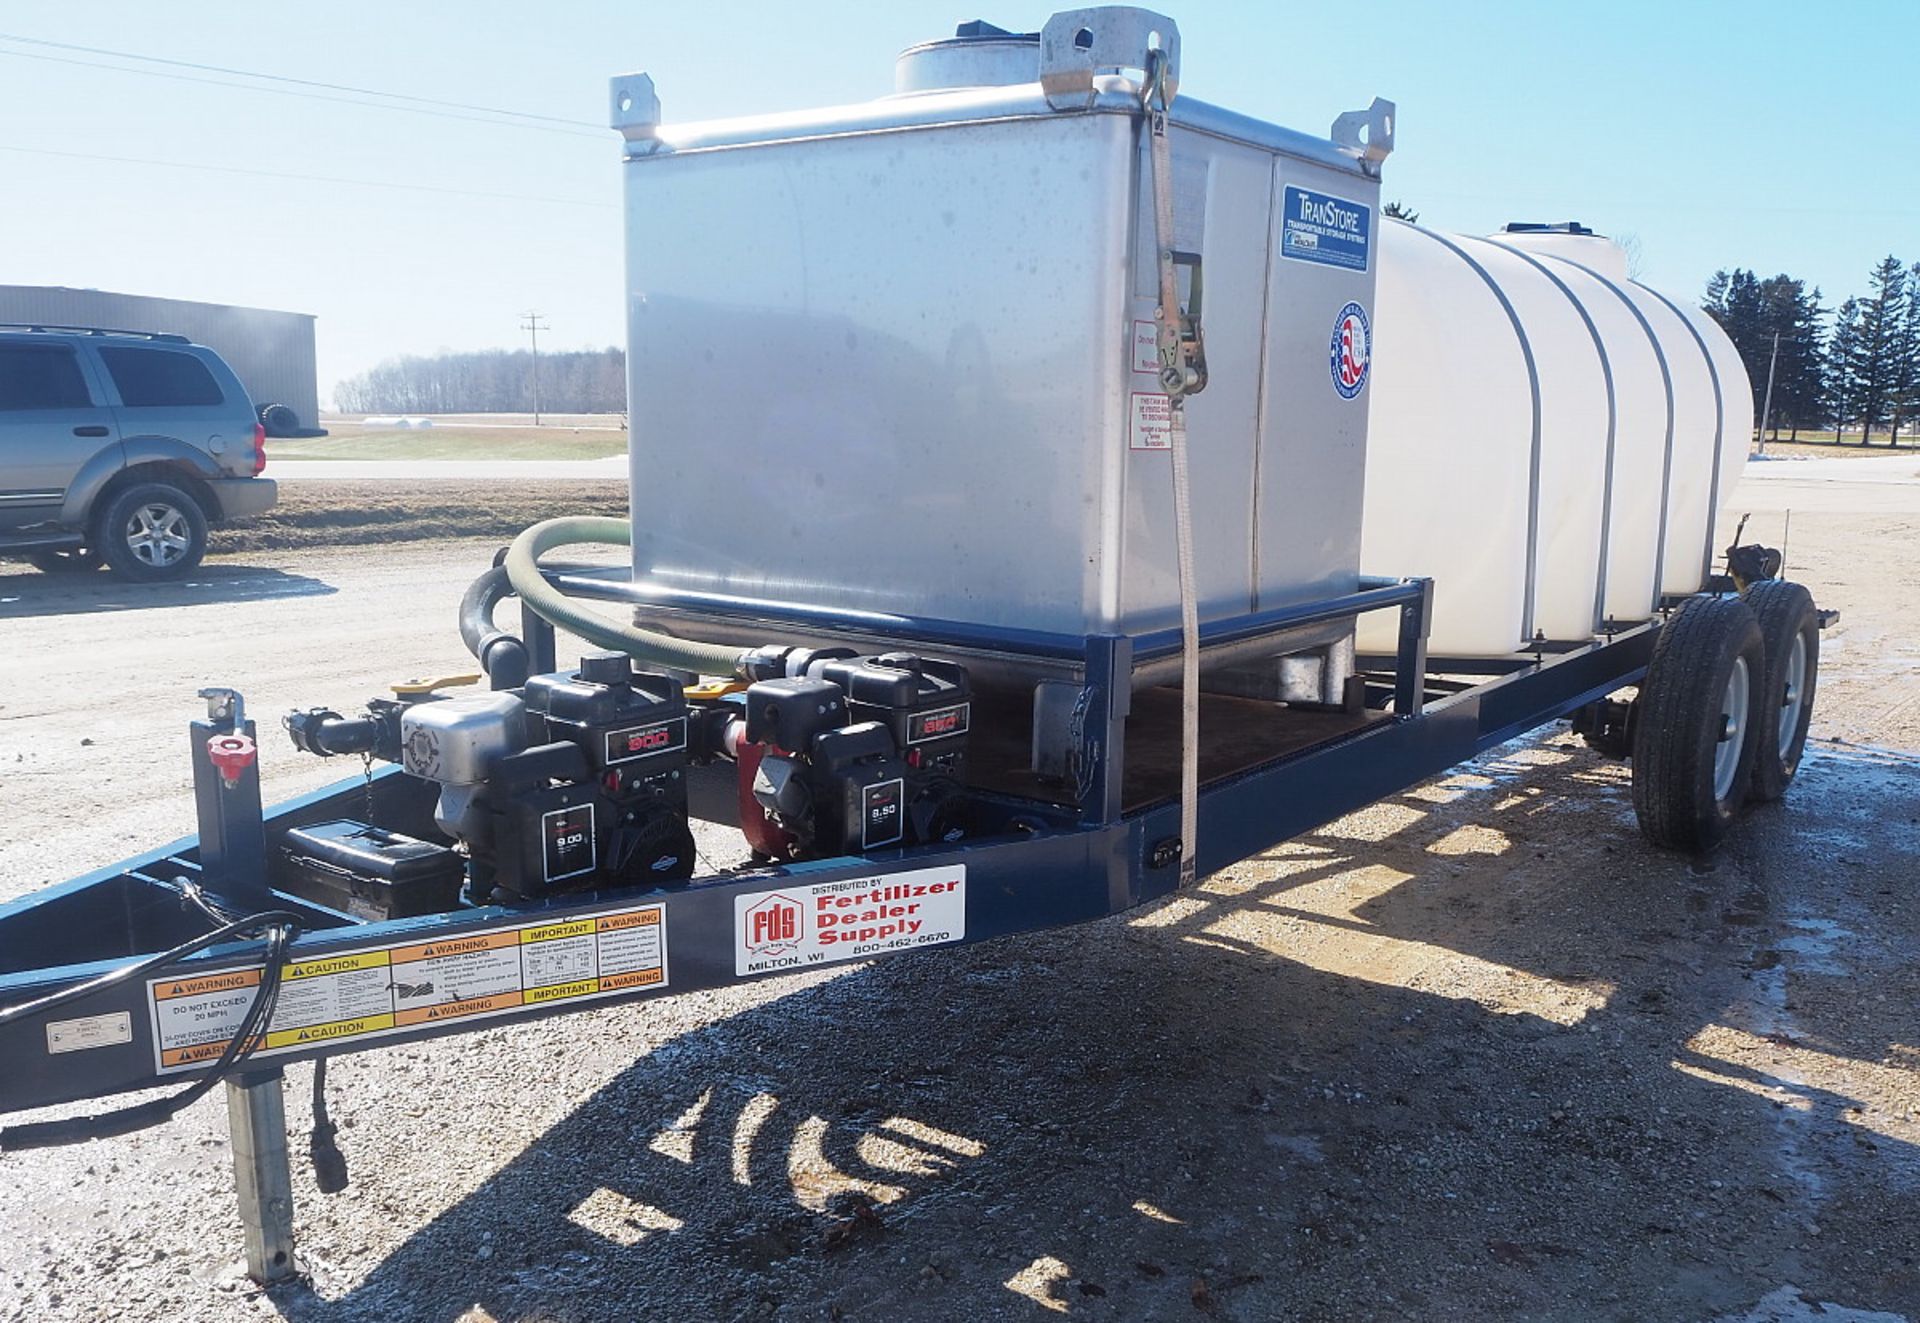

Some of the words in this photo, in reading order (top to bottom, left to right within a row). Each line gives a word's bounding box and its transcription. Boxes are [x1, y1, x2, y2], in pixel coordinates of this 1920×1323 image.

[872, 804, 896, 819] 8.50
[556, 833, 583, 847] 9.00
[812, 881, 868, 895] DISTRIBUTED
[870, 878, 883, 887] BY
[816, 880, 960, 911] Fertilizer
[612, 913, 657, 927] WARNING
[753, 904, 795, 943] fds
[816, 903, 921, 929] Dealer
[530, 924, 588, 940] IMPORTANT
[817, 919, 923, 946] Supply
[436, 939, 489, 954] WARNING
[852, 931, 950, 955] 800-462-6670
[808, 953, 825, 962] WI
[306, 960, 359, 975] CAUTION
[185, 976, 245, 993] WARNING
[613, 972, 659, 987] WARNING
[533, 984, 592, 1000] IMPORTANT
[173, 1006, 187, 1015] DO
[189, 1003, 208, 1012] NOT
[211, 996, 247, 1008] EXCEED
[440, 1000, 492, 1016] WARNING
[207, 1011, 228, 1020] MPH
[311, 1022, 364, 1039] CAUTION
[193, 1046, 228, 1059] WARN
